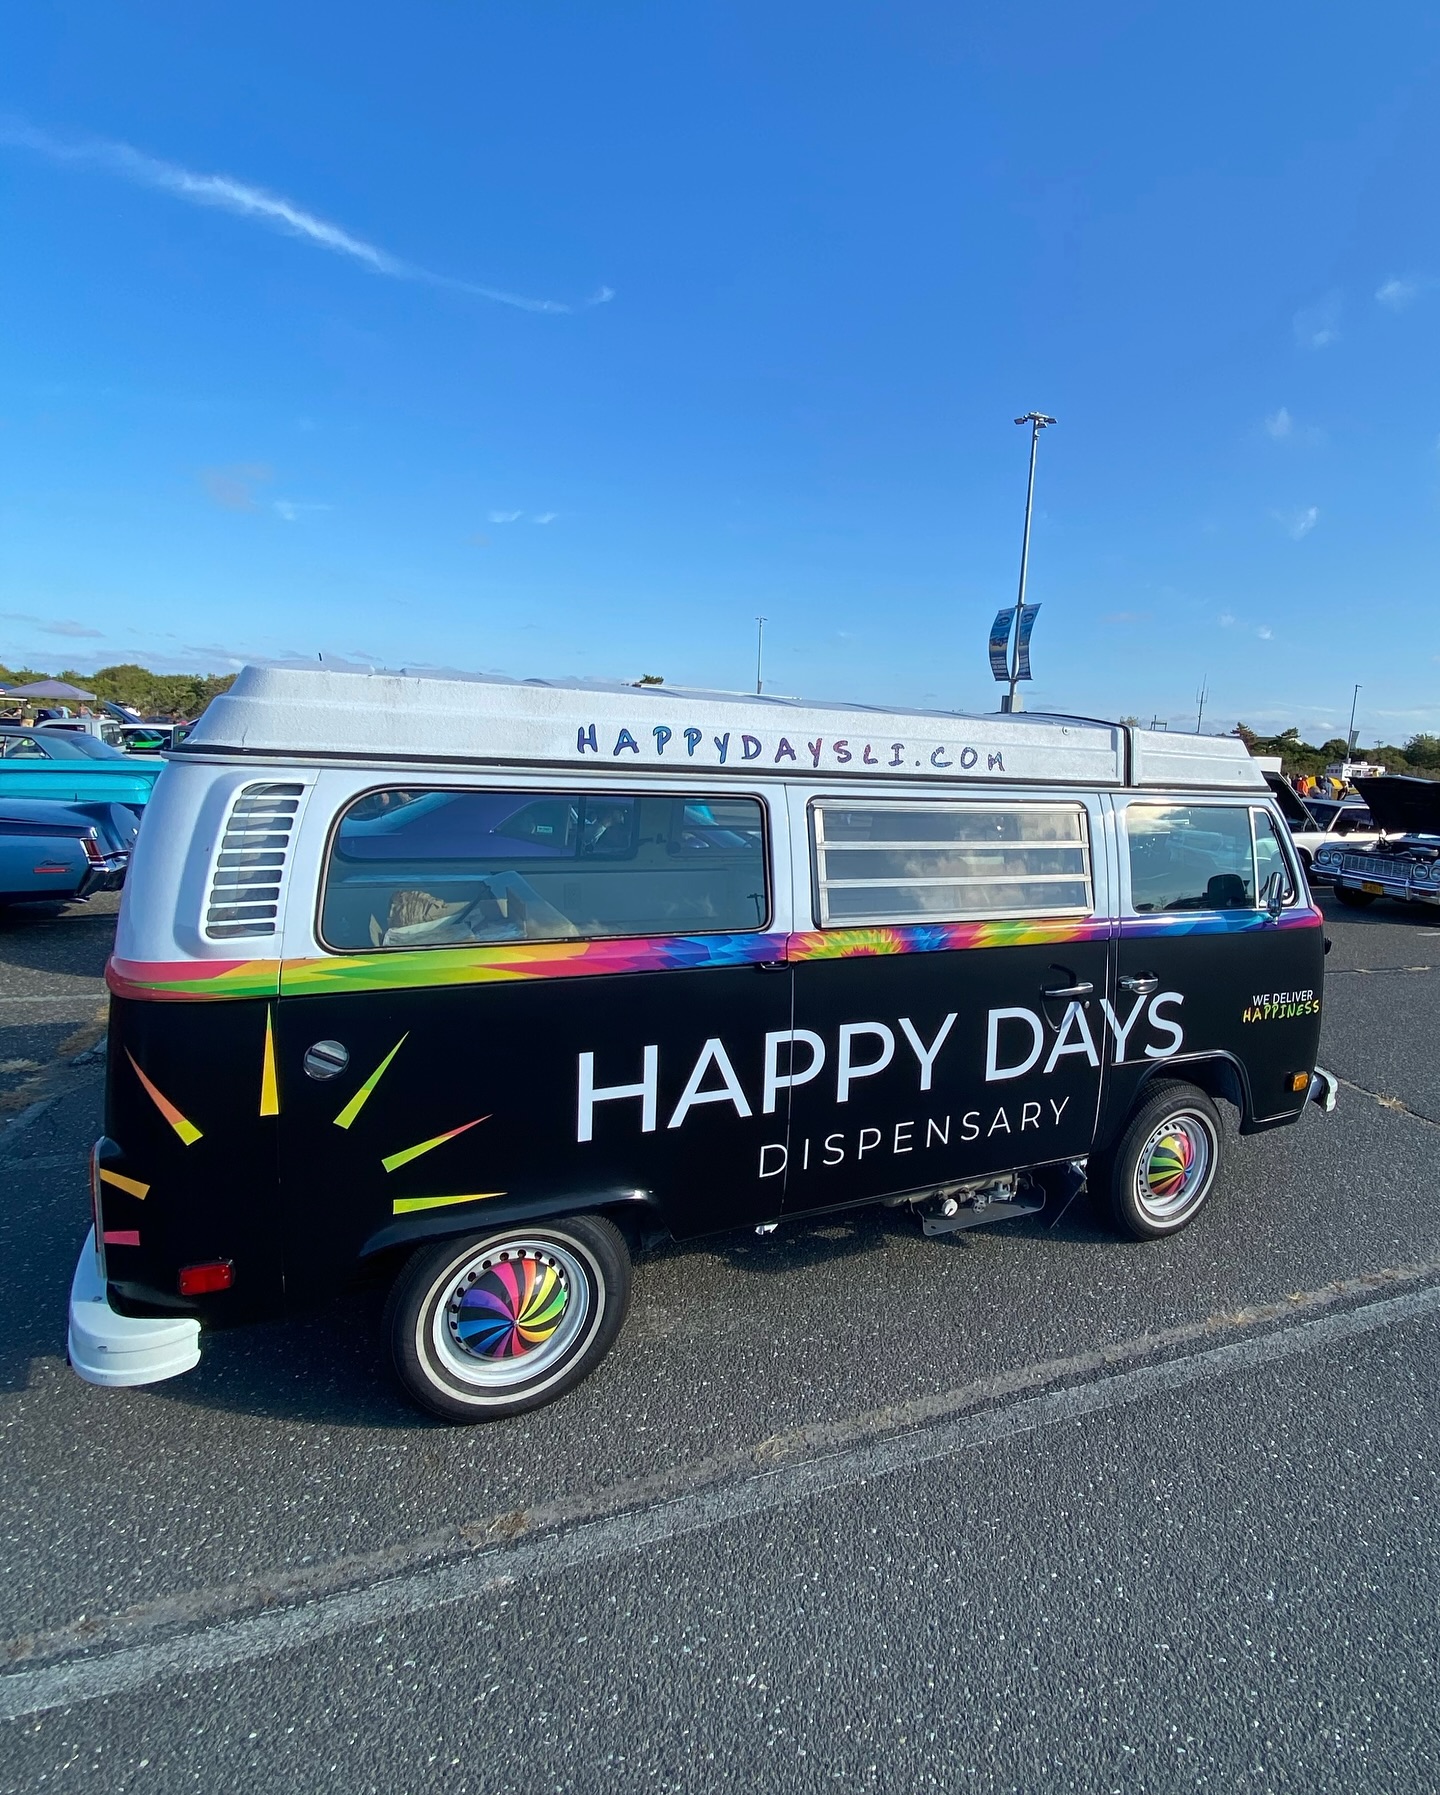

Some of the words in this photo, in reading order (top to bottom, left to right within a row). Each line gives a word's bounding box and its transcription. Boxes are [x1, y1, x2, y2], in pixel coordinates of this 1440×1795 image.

[576, 723, 1006, 772] HAPPYDAYSLI.COM
[1242, 999, 1320, 1024] HAPPINESS
[1252, 993, 1271, 1007] WE
[1272, 989, 1314, 1005] DELIVER
[577, 1012, 959, 1143] HAPPY
[985, 991, 1185, 1082] DAYS
[758, 1096, 1070, 1178] DISPENSARY
